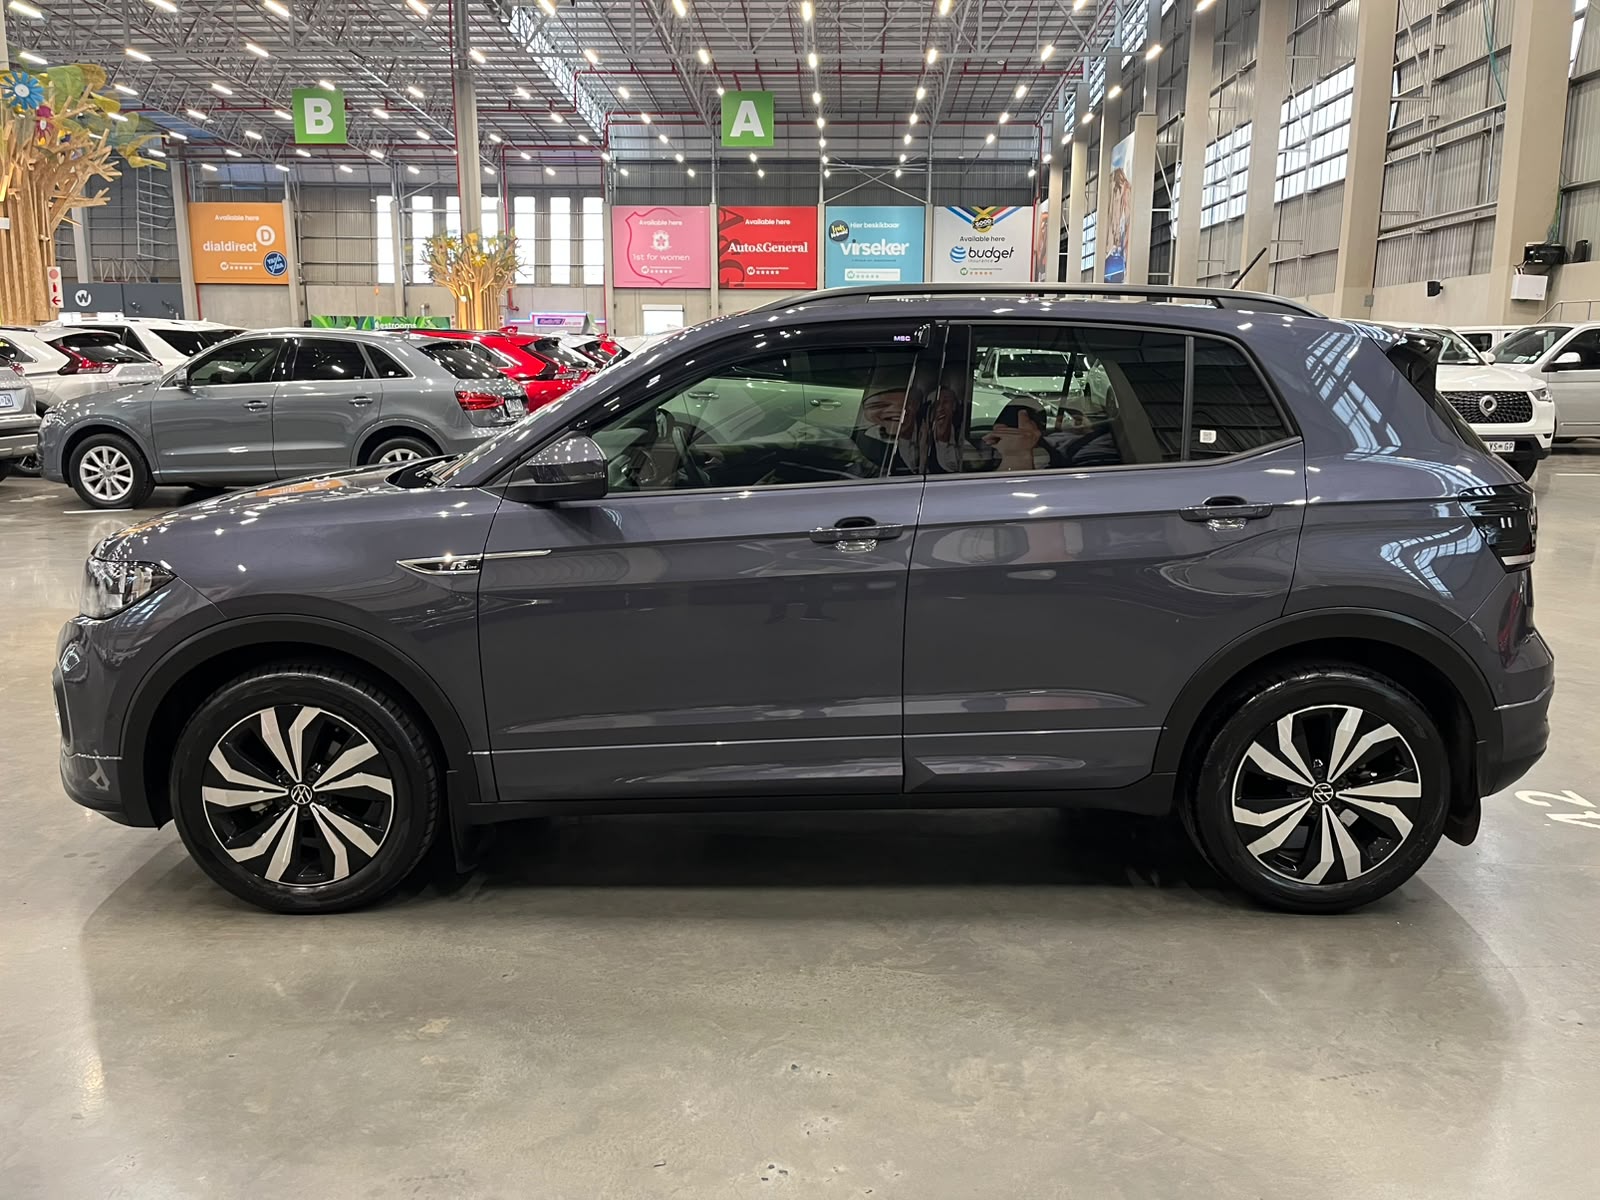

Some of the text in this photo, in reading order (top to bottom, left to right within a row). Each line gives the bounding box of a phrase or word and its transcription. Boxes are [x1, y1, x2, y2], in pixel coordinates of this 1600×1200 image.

[304, 98, 333, 134] B
[730, 101, 764, 137] A
[203, 241, 257, 252] dialdirect
[728, 241, 808, 253] Auto&General
[840, 239, 910, 256] virseker
[968, 246, 1014, 263] budget
[646, 253, 657, 261] for
